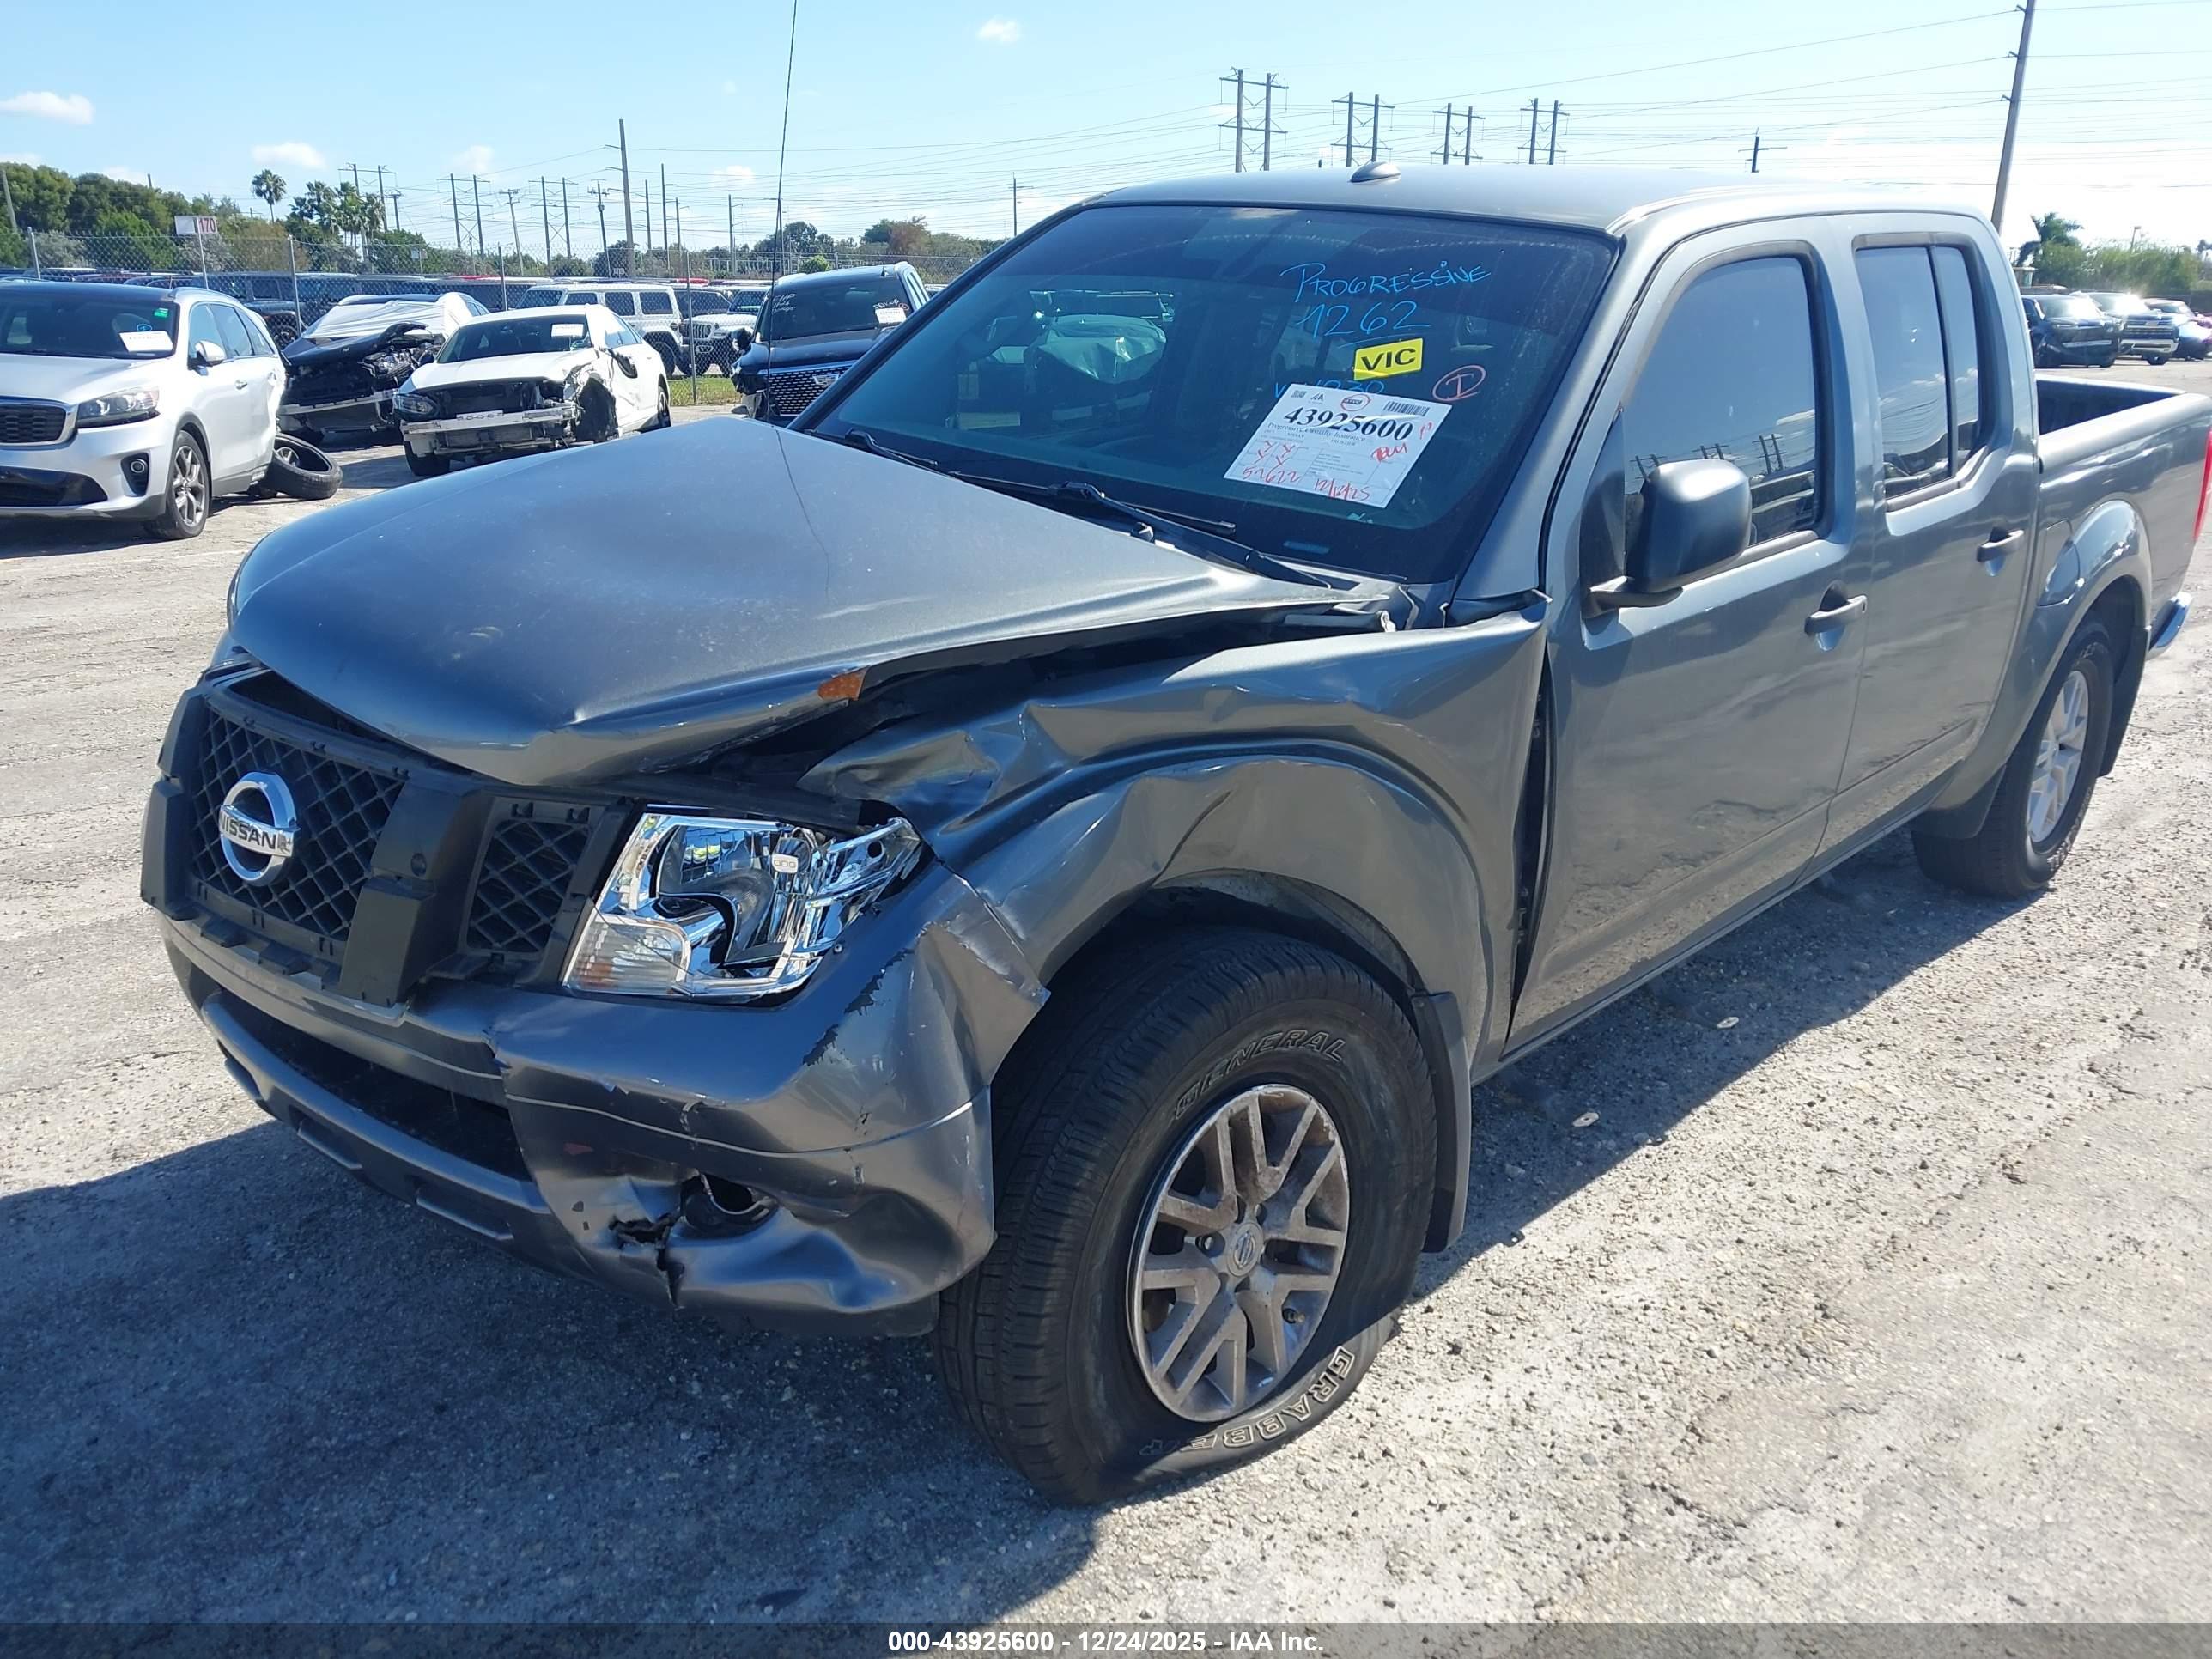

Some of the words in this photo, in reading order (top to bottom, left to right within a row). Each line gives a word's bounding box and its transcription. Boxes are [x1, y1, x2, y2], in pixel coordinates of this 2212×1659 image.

[198, 217, 216, 233] 170
[1361, 348, 1417, 372] VIC
[1283, 406, 1414, 441] 43925600
[220, 811, 277, 850] NISSAN
[1176, 1030, 1346, 1120] GENERAL
